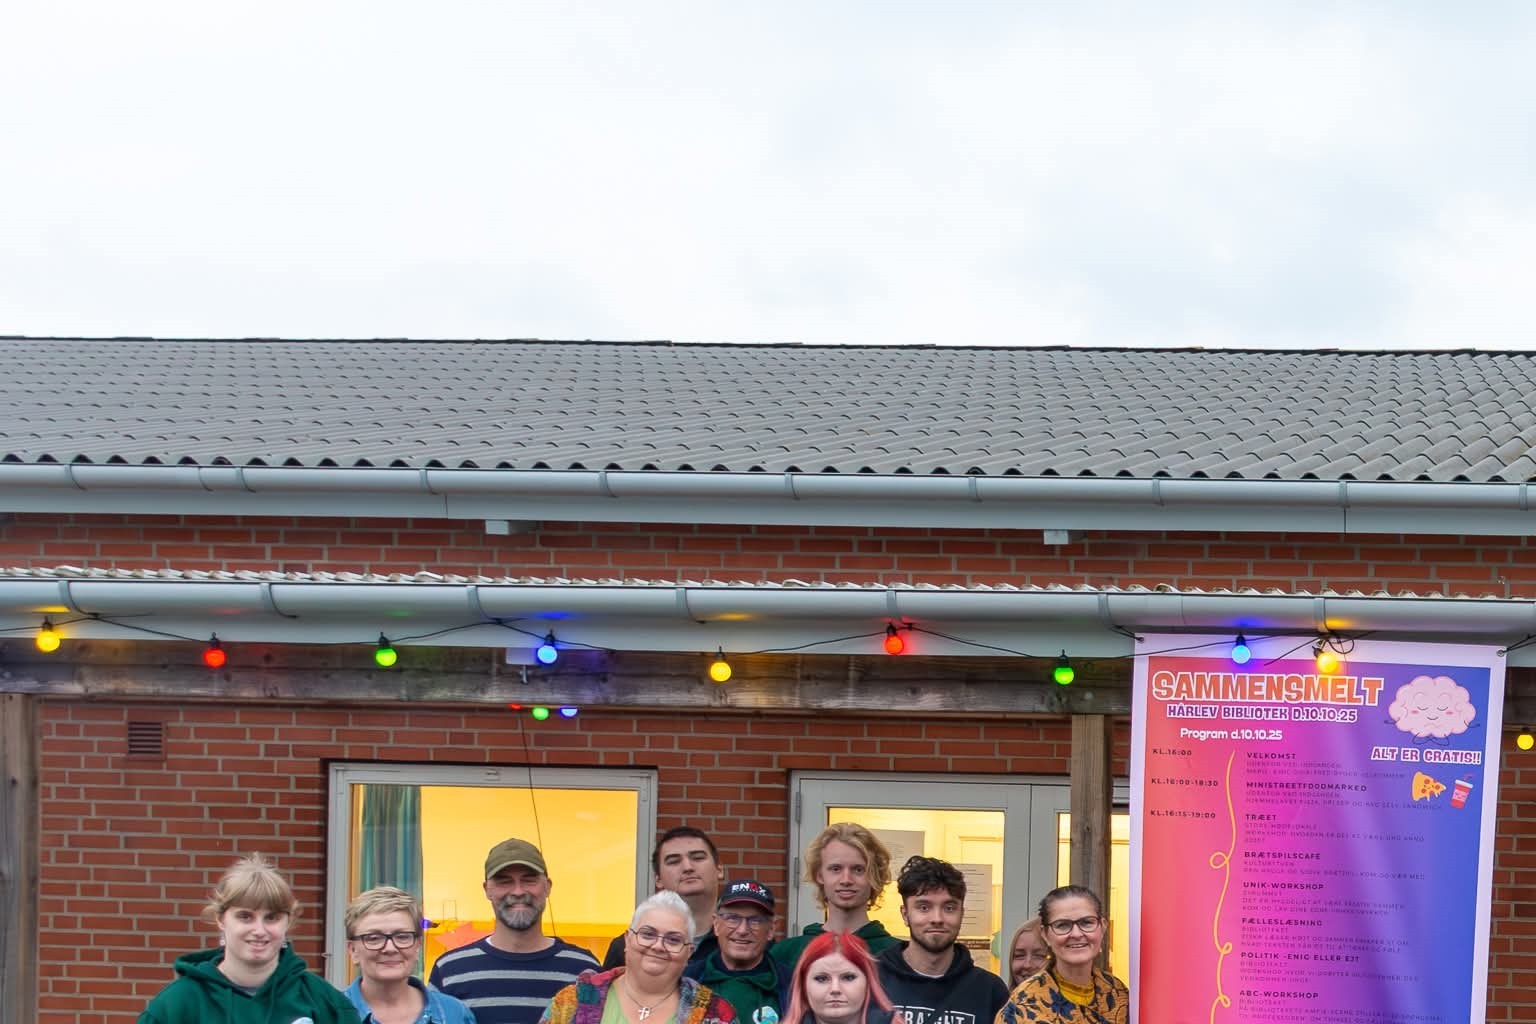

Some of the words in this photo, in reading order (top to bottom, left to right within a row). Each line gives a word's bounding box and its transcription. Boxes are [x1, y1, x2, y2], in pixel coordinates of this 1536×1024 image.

[1152, 671, 1384, 706] SAMMENSMELT
[1167, 703, 1219, 719] HÅRLEV
[1221, 705, 1289, 721] BIBLIOTEK
[1291, 707, 1358, 723] D.10.10.25
[1180, 728, 1228, 741] Program
[1231, 728, 1283, 741] d.10.10.25
[1247, 752, 1297, 760] VELKOMST
[1371, 746, 1398, 760] ALT
[1401, 747, 1420, 762] ER
[1423, 749, 1481, 764] GRATIS!!
[1243, 881, 1325, 890] UNIK-WORKSHOP
[1241, 917, 1323, 927] FÆLLESLÆSNING
[1240, 952, 1279, 960] POLITIK
[1313, 954, 1341, 962] ELLER
[1239, 990, 1319, 999] ABC-WORKSHOP
